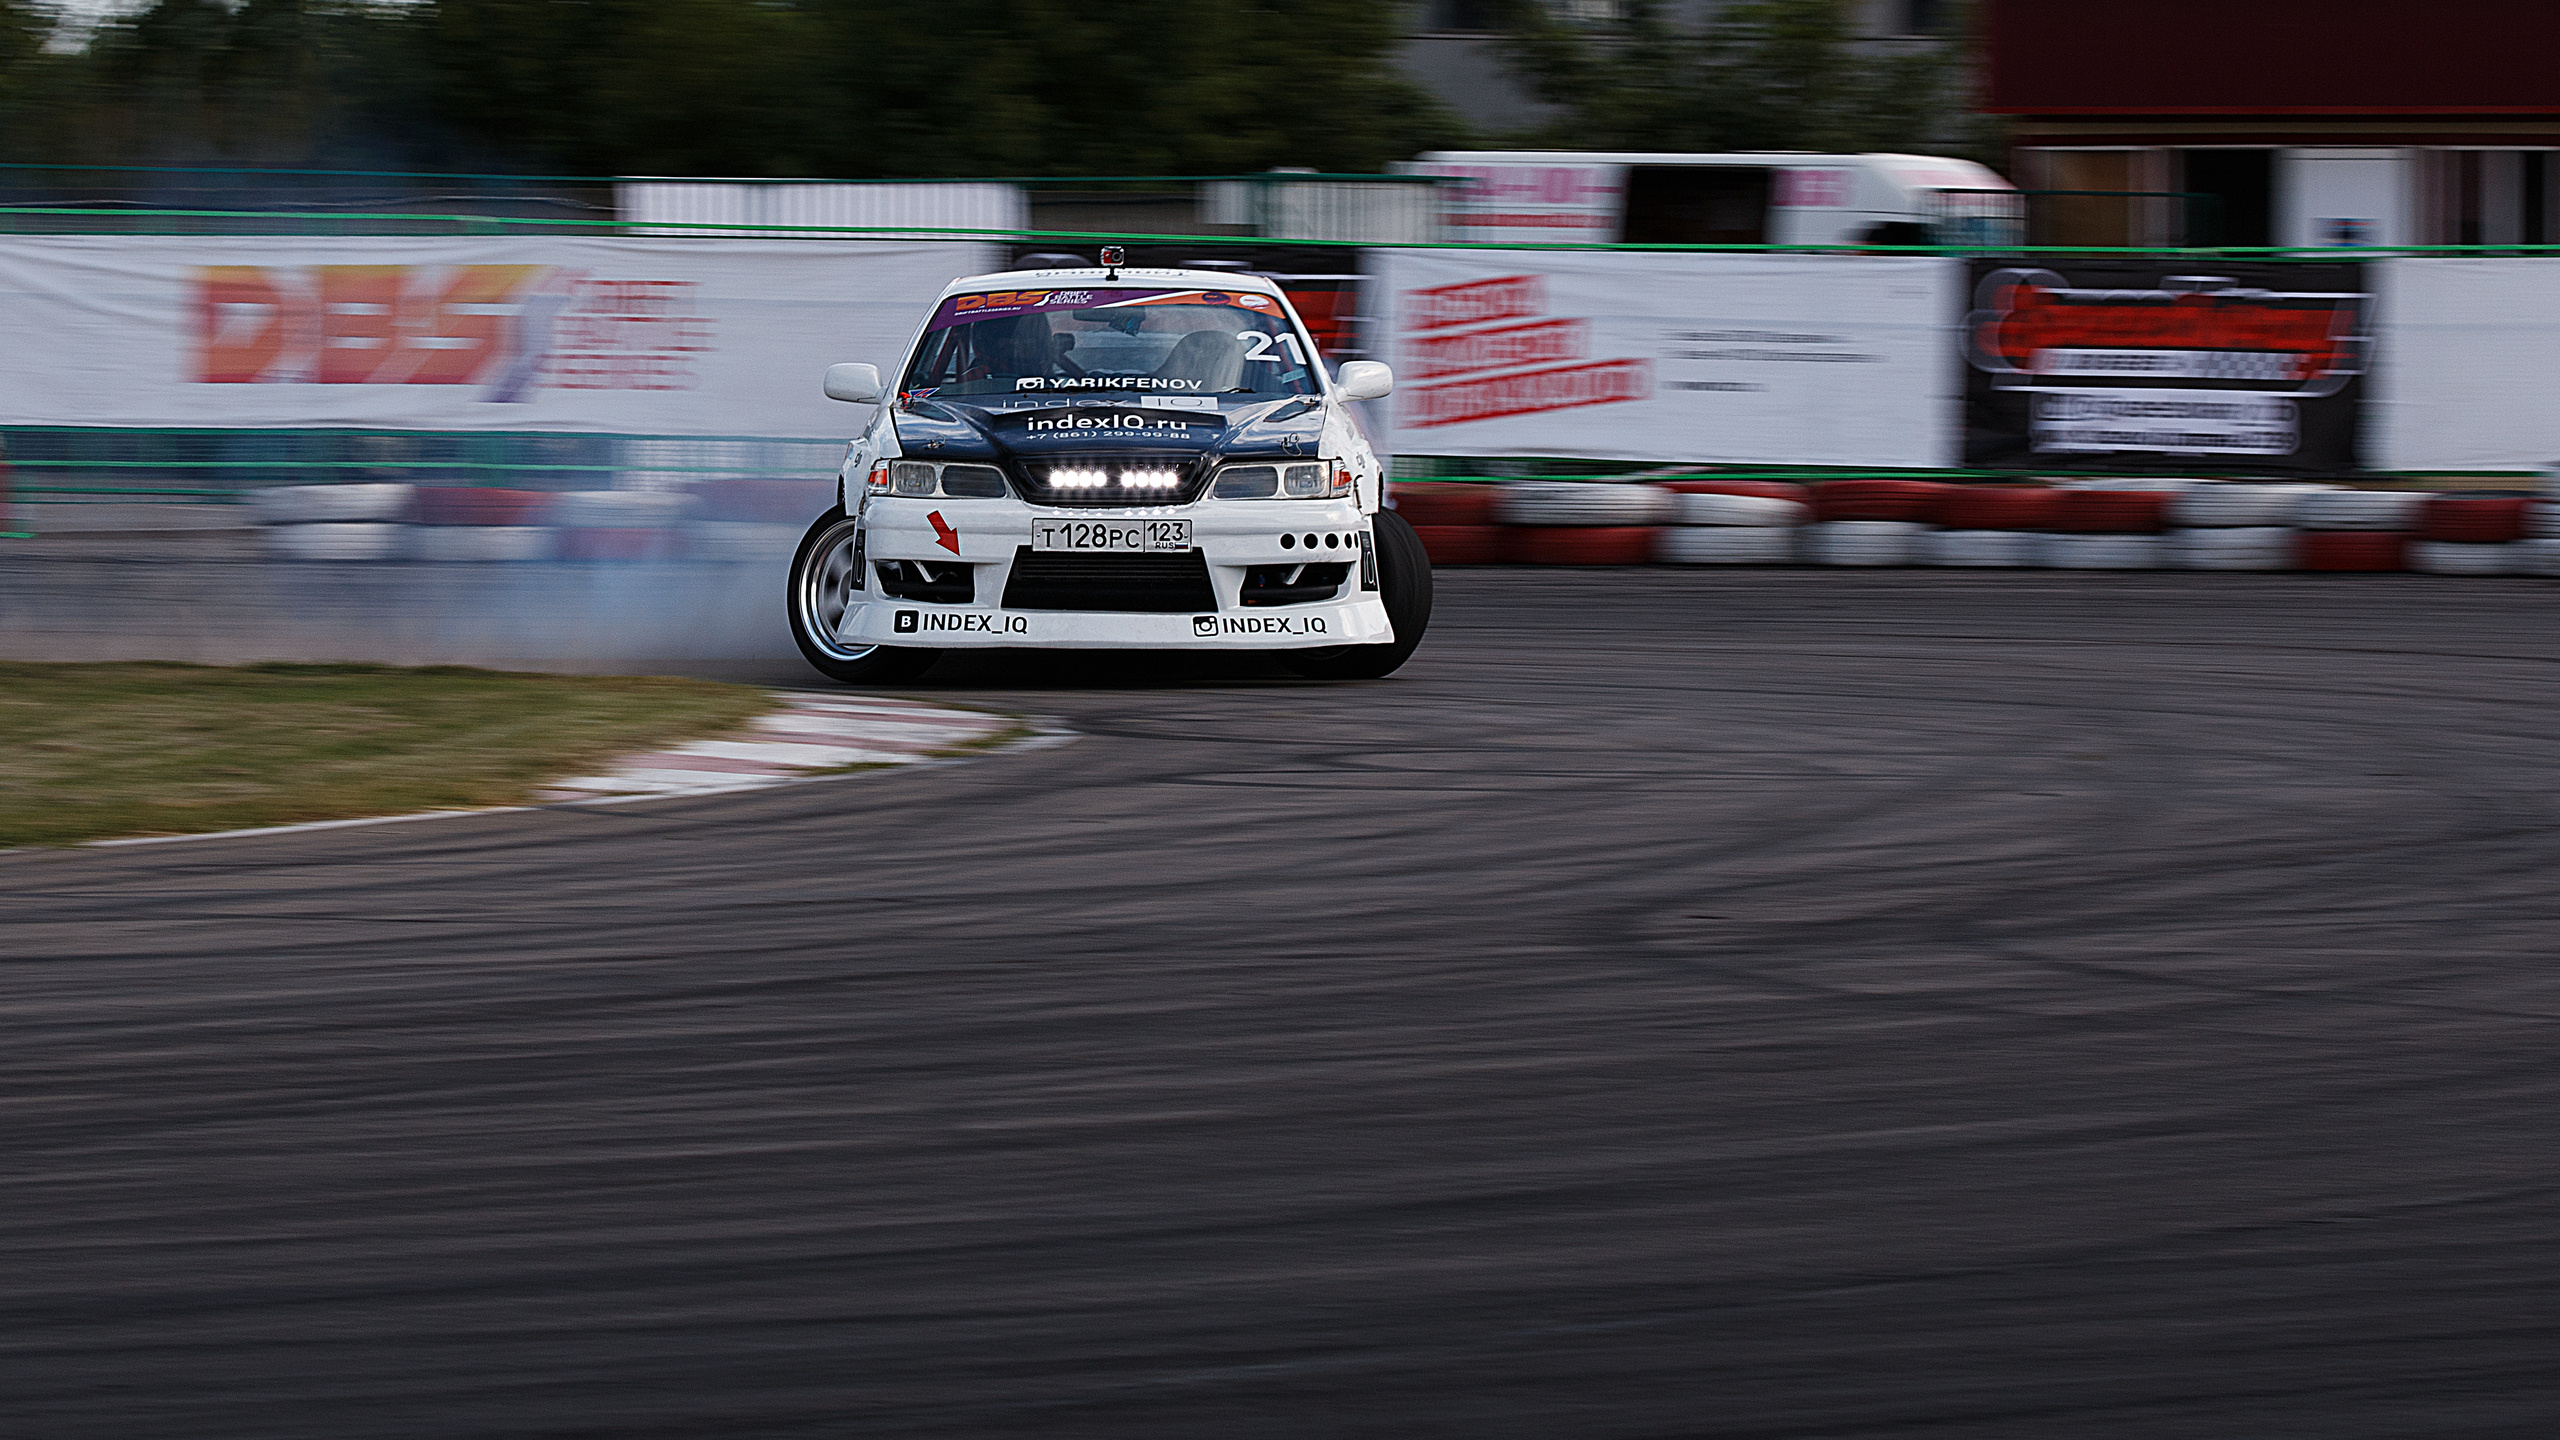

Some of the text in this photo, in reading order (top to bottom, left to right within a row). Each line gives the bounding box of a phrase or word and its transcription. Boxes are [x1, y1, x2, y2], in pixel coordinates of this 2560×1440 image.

[956, 291, 1052, 311] DBS
[1236, 330, 1307, 365] 21
[1050, 377, 1203, 390] YARIKFENOV
[1027, 414, 1188, 431] indexIQ.ru
[1103, 431, 1191, 440] 299-99-88
[1147, 522, 1183, 542] 123
[1155, 542, 1174, 550] RUS
[923, 613, 1028, 635] INDEX_IQ
[1222, 617, 1327, 635] INDEX_IQ
